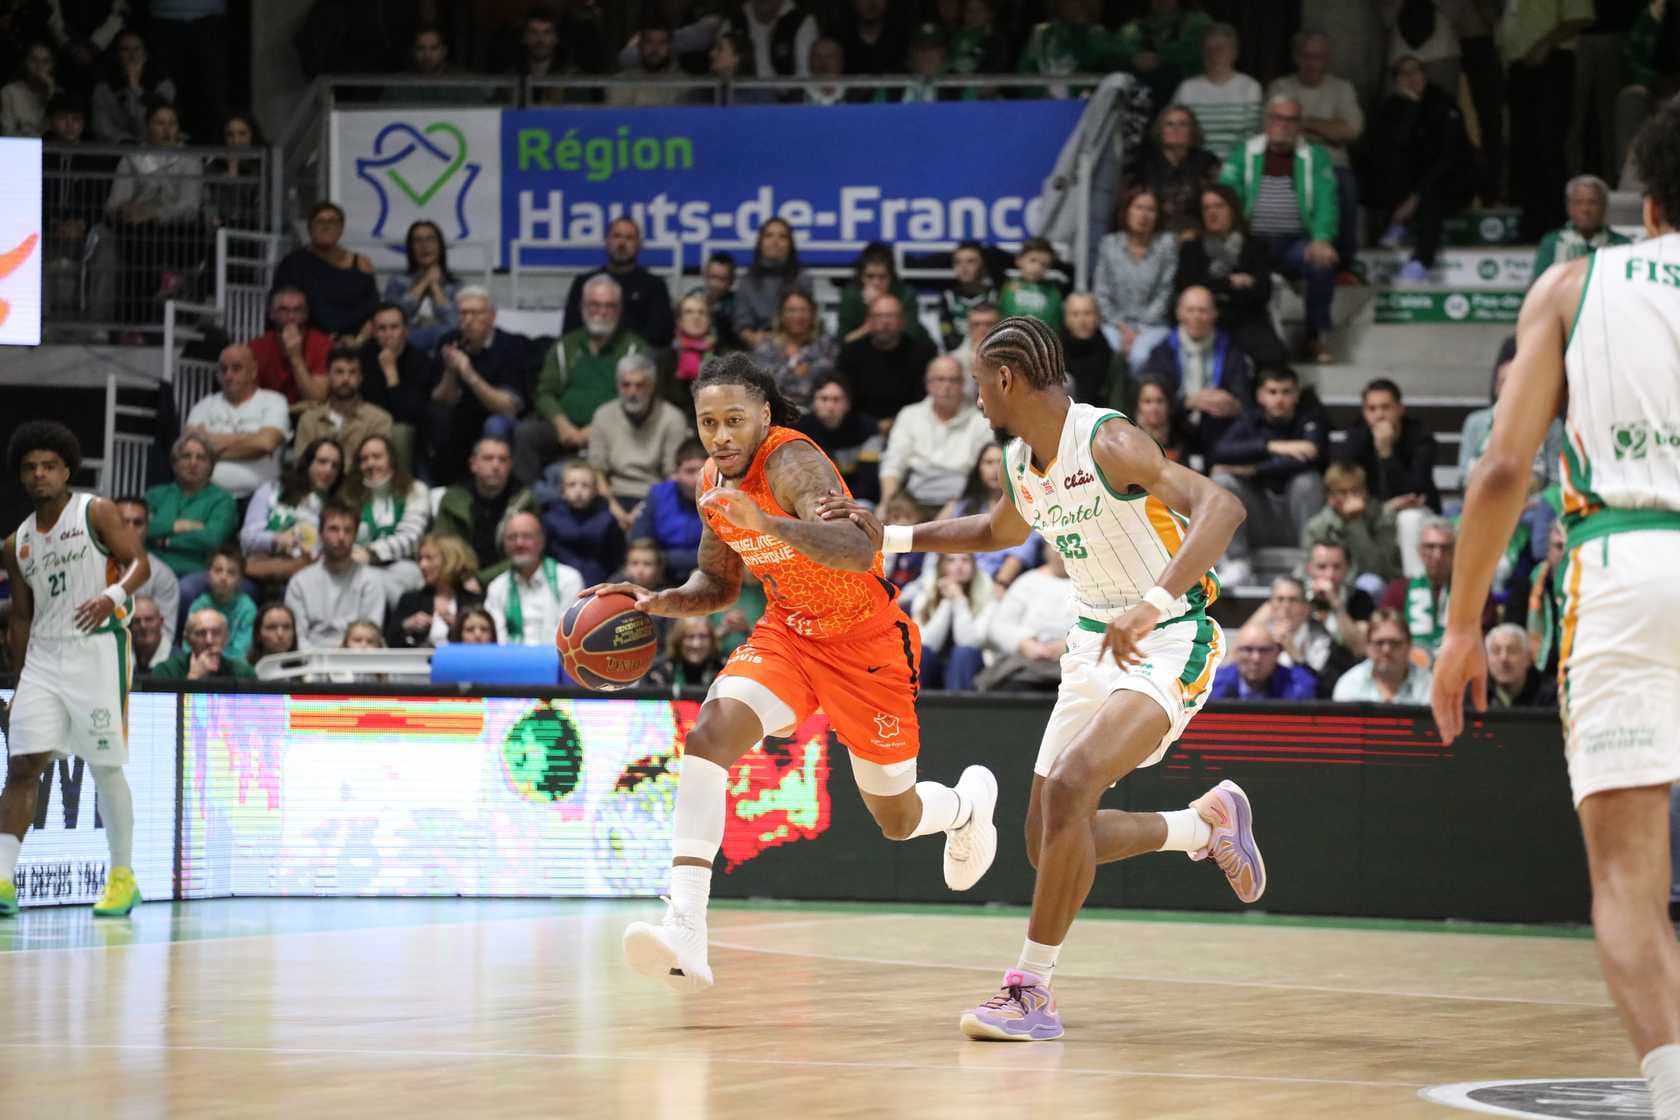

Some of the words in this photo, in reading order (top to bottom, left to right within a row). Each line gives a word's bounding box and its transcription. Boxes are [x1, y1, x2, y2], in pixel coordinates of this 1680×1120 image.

[518, 126, 694, 181] Région
[1048, 495, 1103, 528] Portel
[42, 546, 87, 570] Portel
[48, 571, 66, 597] 21
